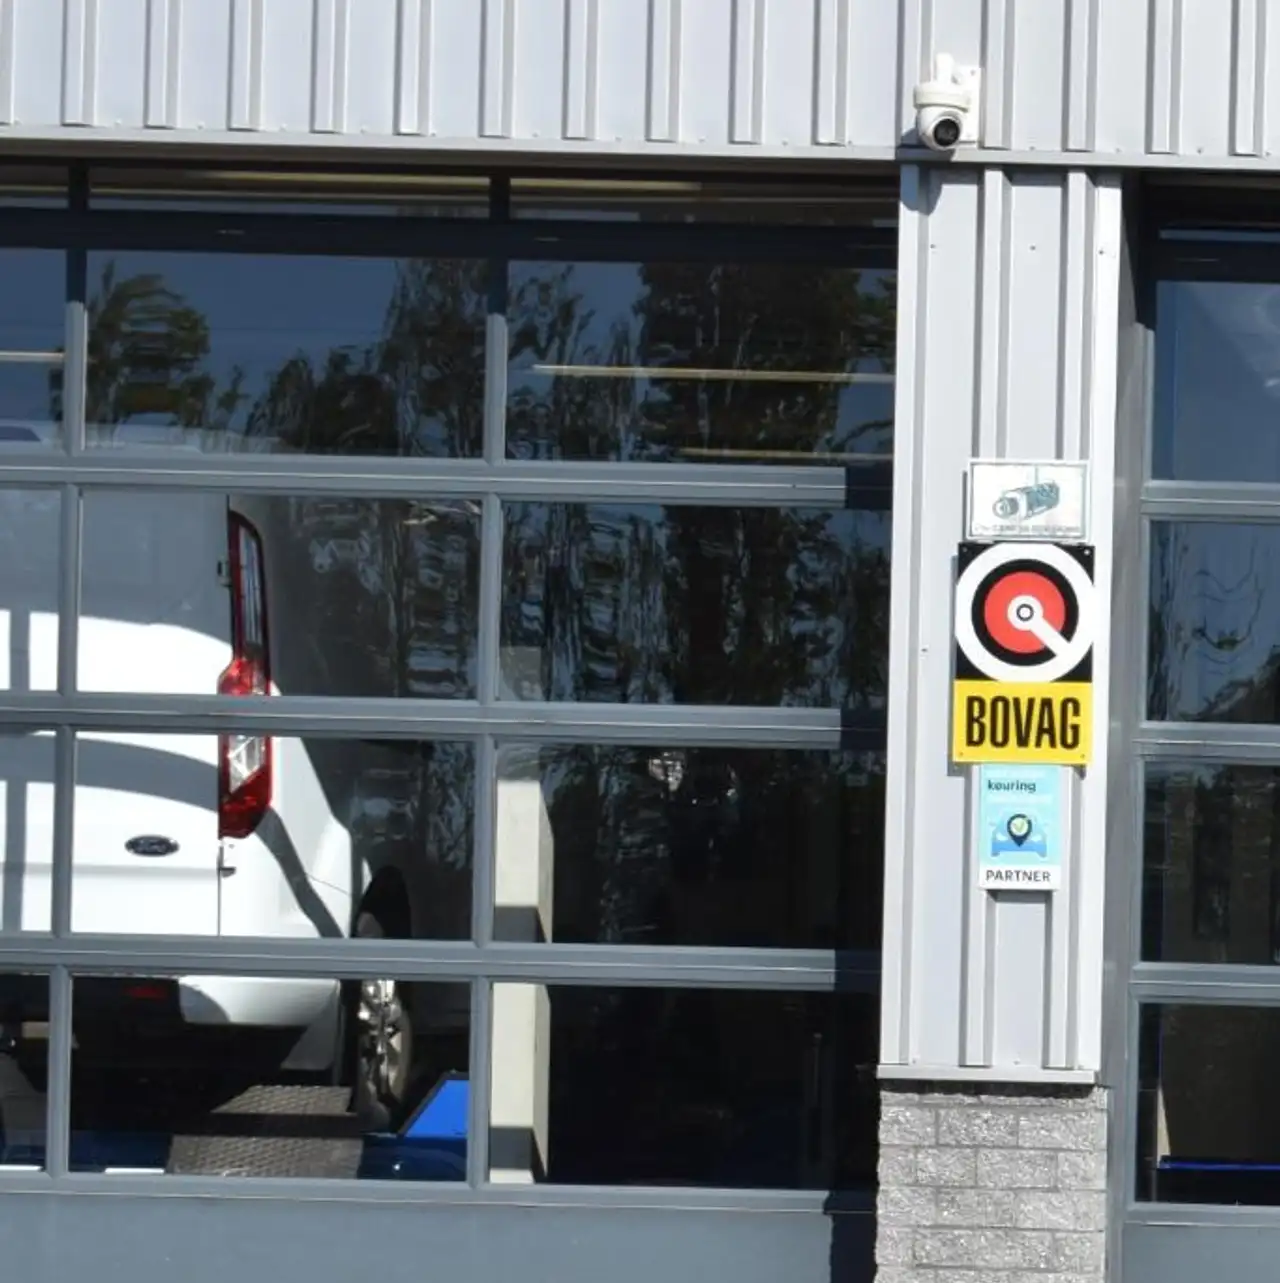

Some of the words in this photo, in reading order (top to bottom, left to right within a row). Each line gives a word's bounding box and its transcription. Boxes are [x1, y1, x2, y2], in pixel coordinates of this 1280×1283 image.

[966, 695, 1080, 749] BOVAG
[987, 779, 1037, 794] keuring
[985, 869, 1051, 882] PARTNER
